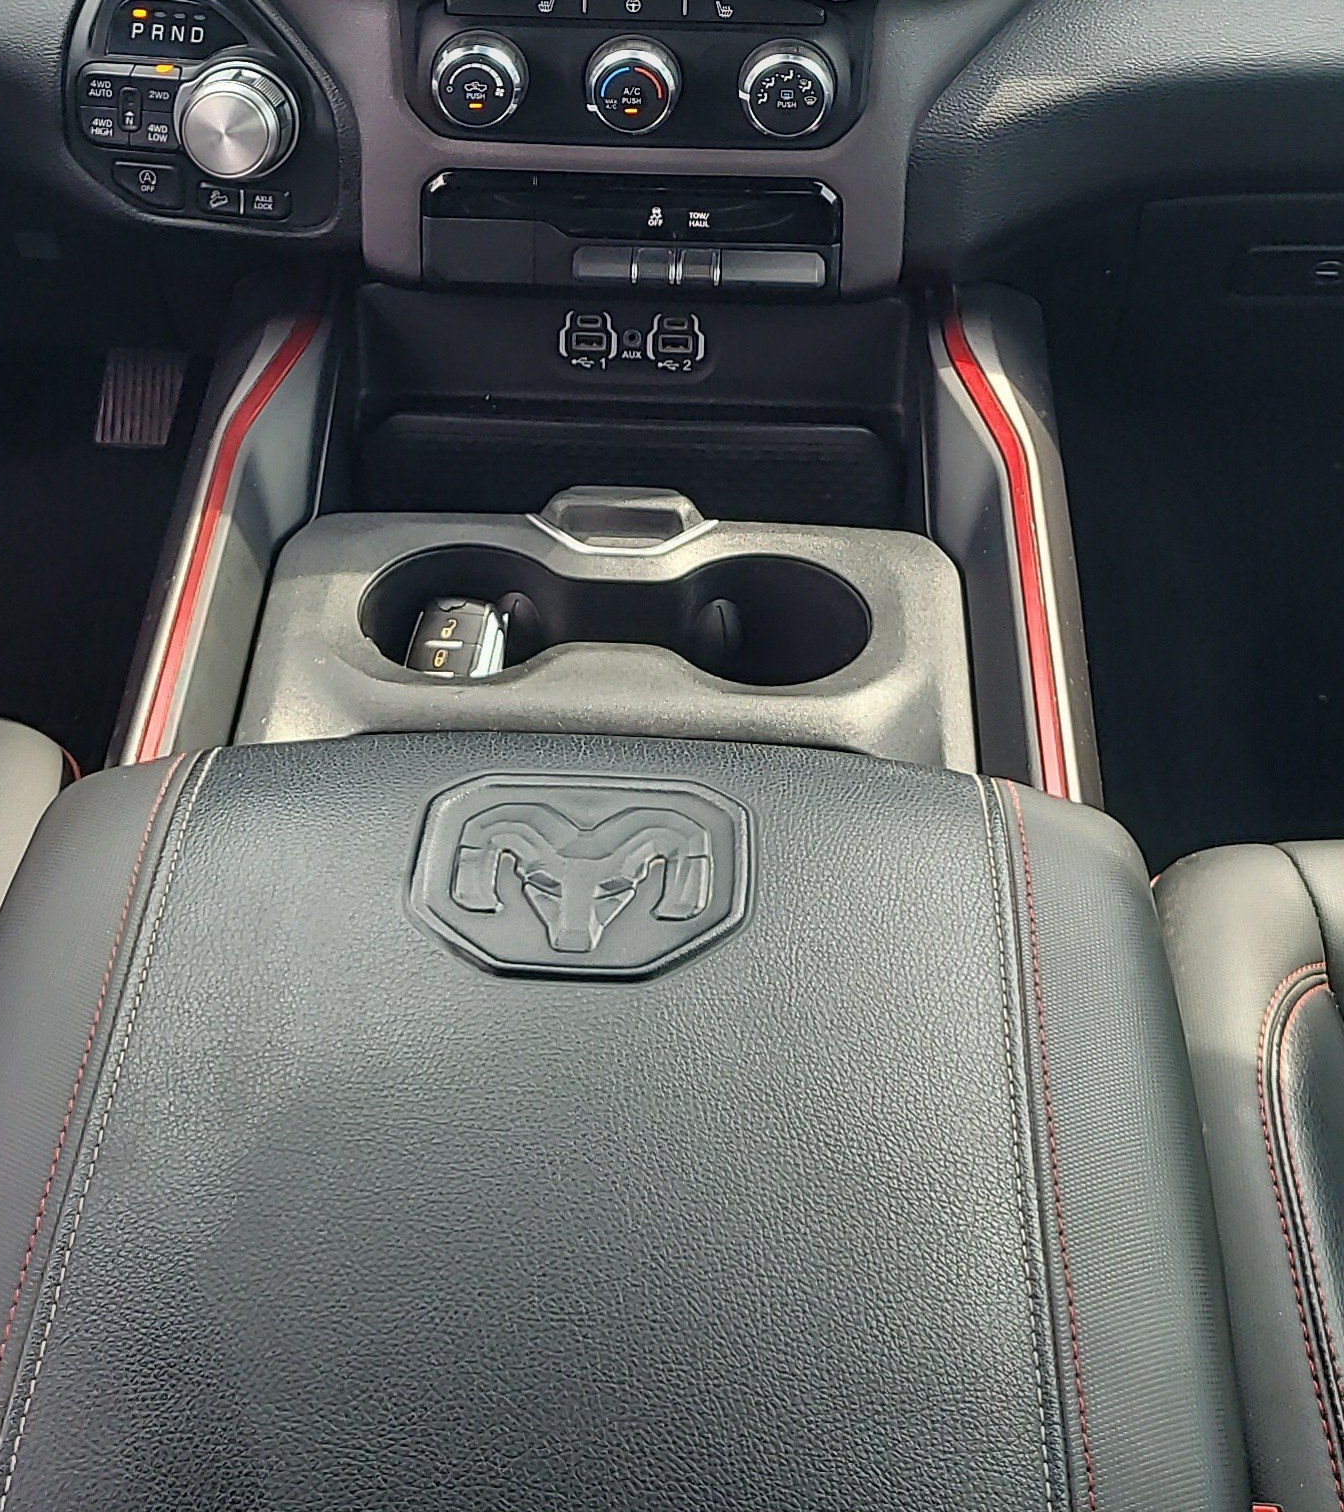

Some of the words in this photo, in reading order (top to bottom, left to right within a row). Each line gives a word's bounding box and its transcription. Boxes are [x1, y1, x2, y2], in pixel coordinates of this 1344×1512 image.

[131, 23, 144, 39] P
[151, 24, 164, 41] R
[171, 25, 184, 42] N
[190, 27, 204, 43] D
[90, 80, 111, 89] 4WD
[89, 88, 113, 98] AUTO
[149, 90, 169, 100] 2WD
[466, 91, 486, 100] PUSH
[623, 86, 641, 96] A/C
[777, 100, 797, 109] PUSH
[92, 118, 113, 128] 4WD
[125, 116, 134, 126] N
[91, 126, 113, 137] HIGH
[148, 124, 168, 134] 4WD
[148, 133, 168, 143] LOW
[140, 184, 155, 193] OFF
[255, 194, 273, 203] AXLE
[254, 202, 273, 211] LOCK
[648, 218, 664, 227] OFF
[688, 219, 710, 228] HAUL
[621, 350, 642, 360] AUX
[599, 358, 606, 369] 1
[682, 359, 692, 370] 2
